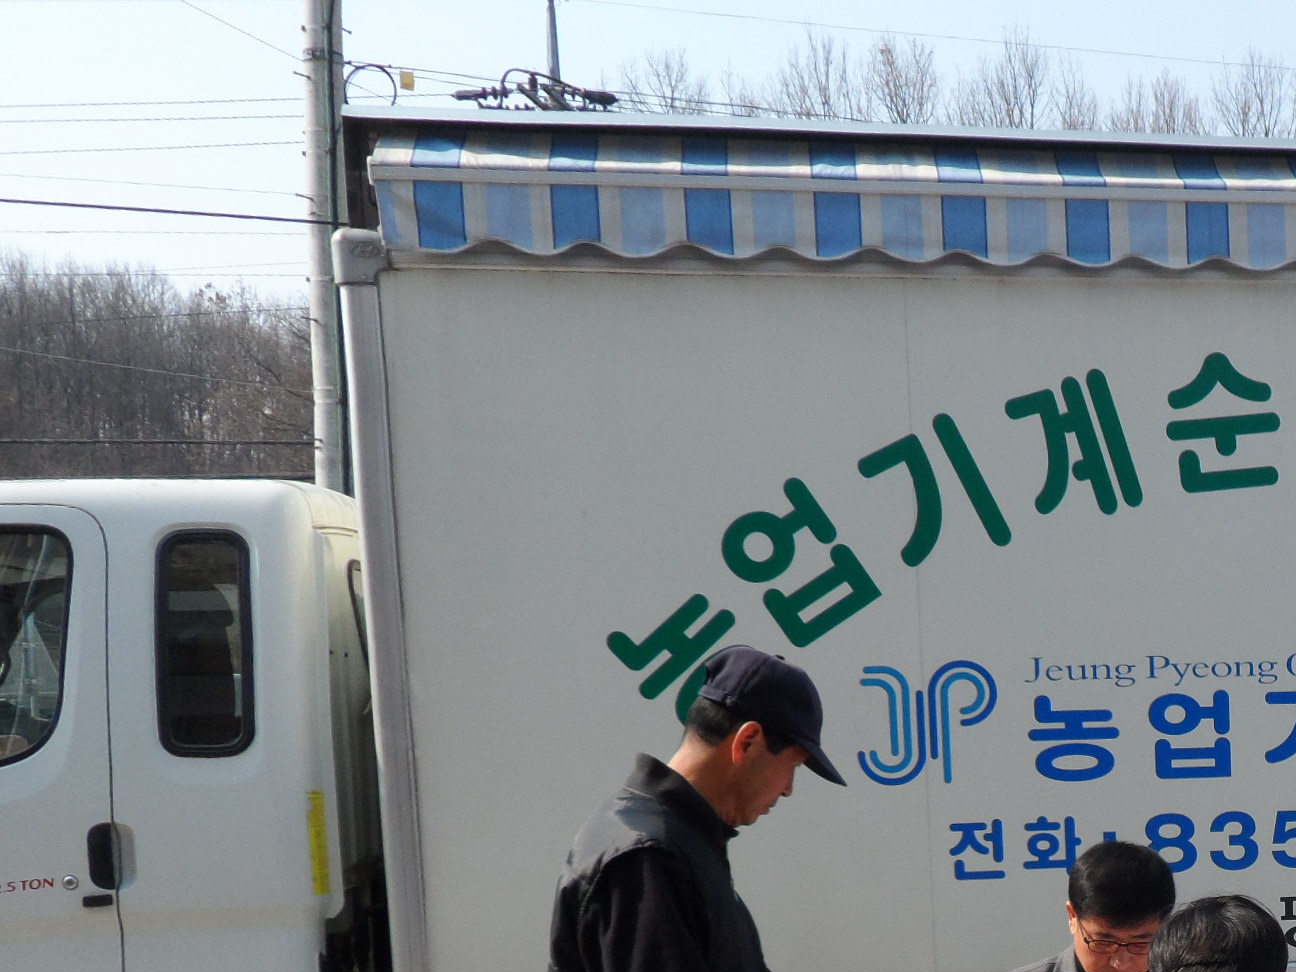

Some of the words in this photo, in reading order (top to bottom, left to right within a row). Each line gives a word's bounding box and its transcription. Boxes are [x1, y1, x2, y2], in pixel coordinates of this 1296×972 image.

[1024, 656, 1136, 688] Jeung
[1145, 655, 1278, 686] Pyeong
[20, 878, 55, 891] TON
